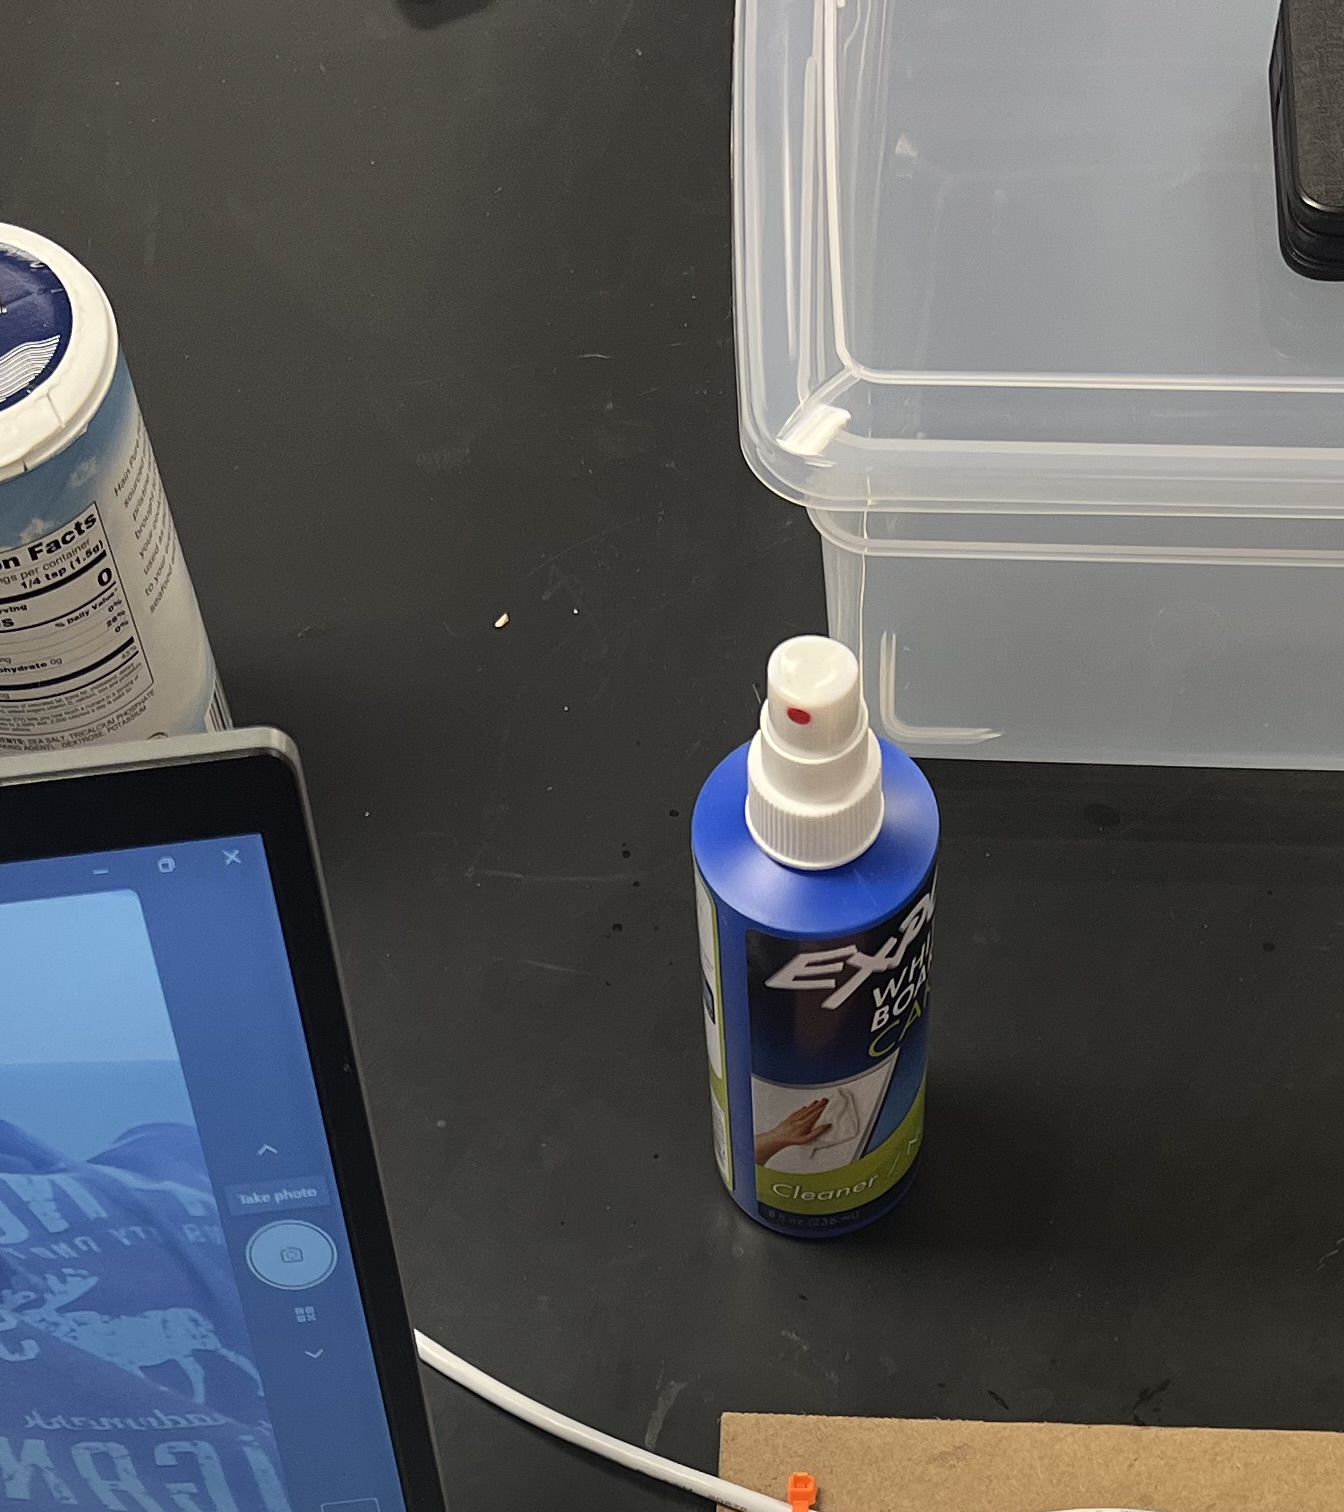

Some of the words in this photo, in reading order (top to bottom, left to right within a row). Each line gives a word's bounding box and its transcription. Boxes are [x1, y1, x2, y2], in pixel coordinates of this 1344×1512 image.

[28, 513, 97, 561] Facts
[20, 566, 39, 581] per
[43, 538, 90, 571] container
[21, 577, 41, 589] 1/4
[45, 567, 66, 581] tsp
[69, 540, 104, 570] (1.5g)
[97, 568, 113, 587] 0
[67, 609, 90, 625] Daily
[238, 1192, 271, 1205] Take
[274, 1187, 318, 1204] photo
[773, 1174, 879, 1200] Cleaner
